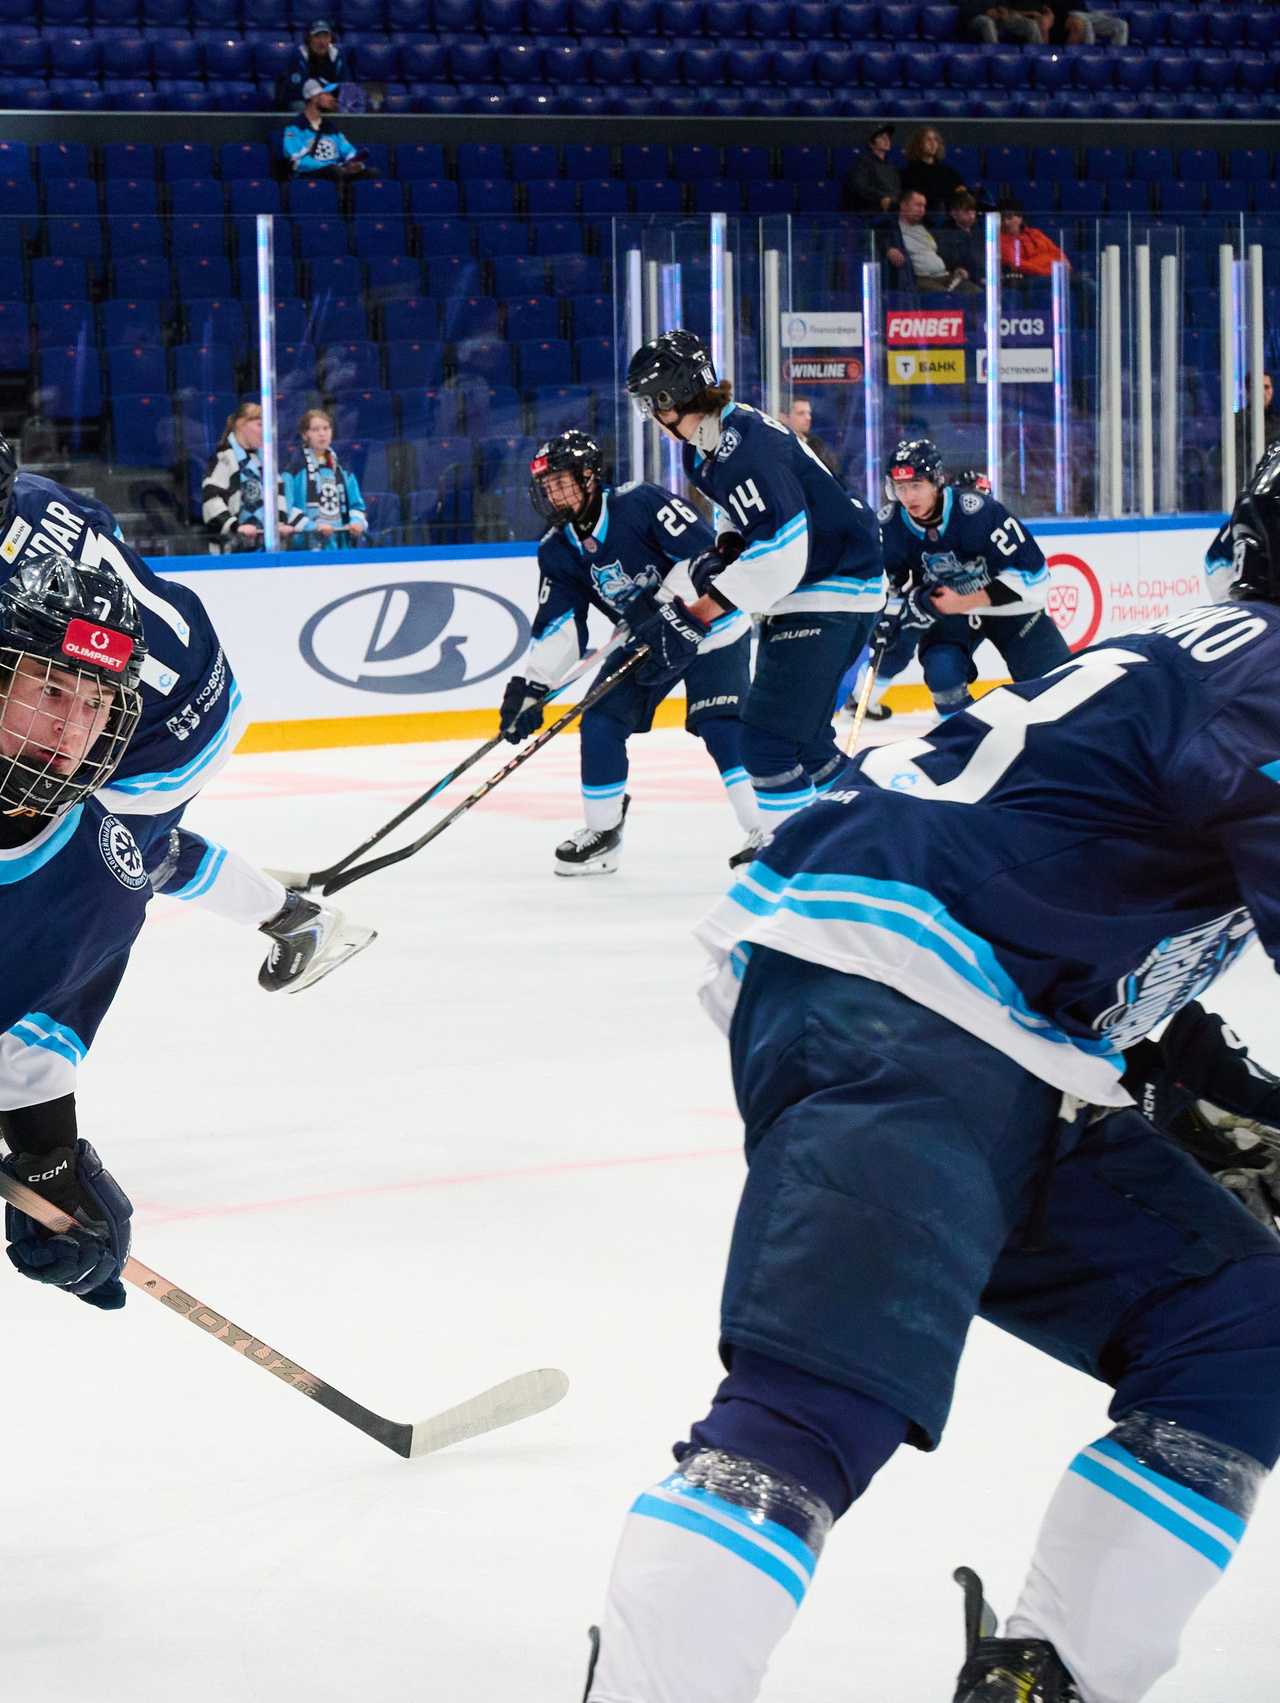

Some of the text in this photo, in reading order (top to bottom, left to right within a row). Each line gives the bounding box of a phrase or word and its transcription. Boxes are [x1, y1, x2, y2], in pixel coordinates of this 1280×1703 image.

[888, 317, 962, 338] FONBET
[984, 317, 1045, 337] огаз
[791, 362, 846, 379] WINLINE
[919, 361, 957, 373] БАНК
[997, 365, 1049, 376] остелеком
[728, 478, 766, 526] 14
[656, 498, 699, 537] 26
[990, 517, 1026, 556] 27
[1110, 575, 1200, 600] НА ОДНОЙ
[93, 596, 111, 621] 7
[1111, 604, 1169, 622] ЛИНИИ
[65, 643, 123, 668] OLIMPBET
[27, 1159, 68, 1183] CCM
[160, 1288, 317, 1397] SOYUZ BC
